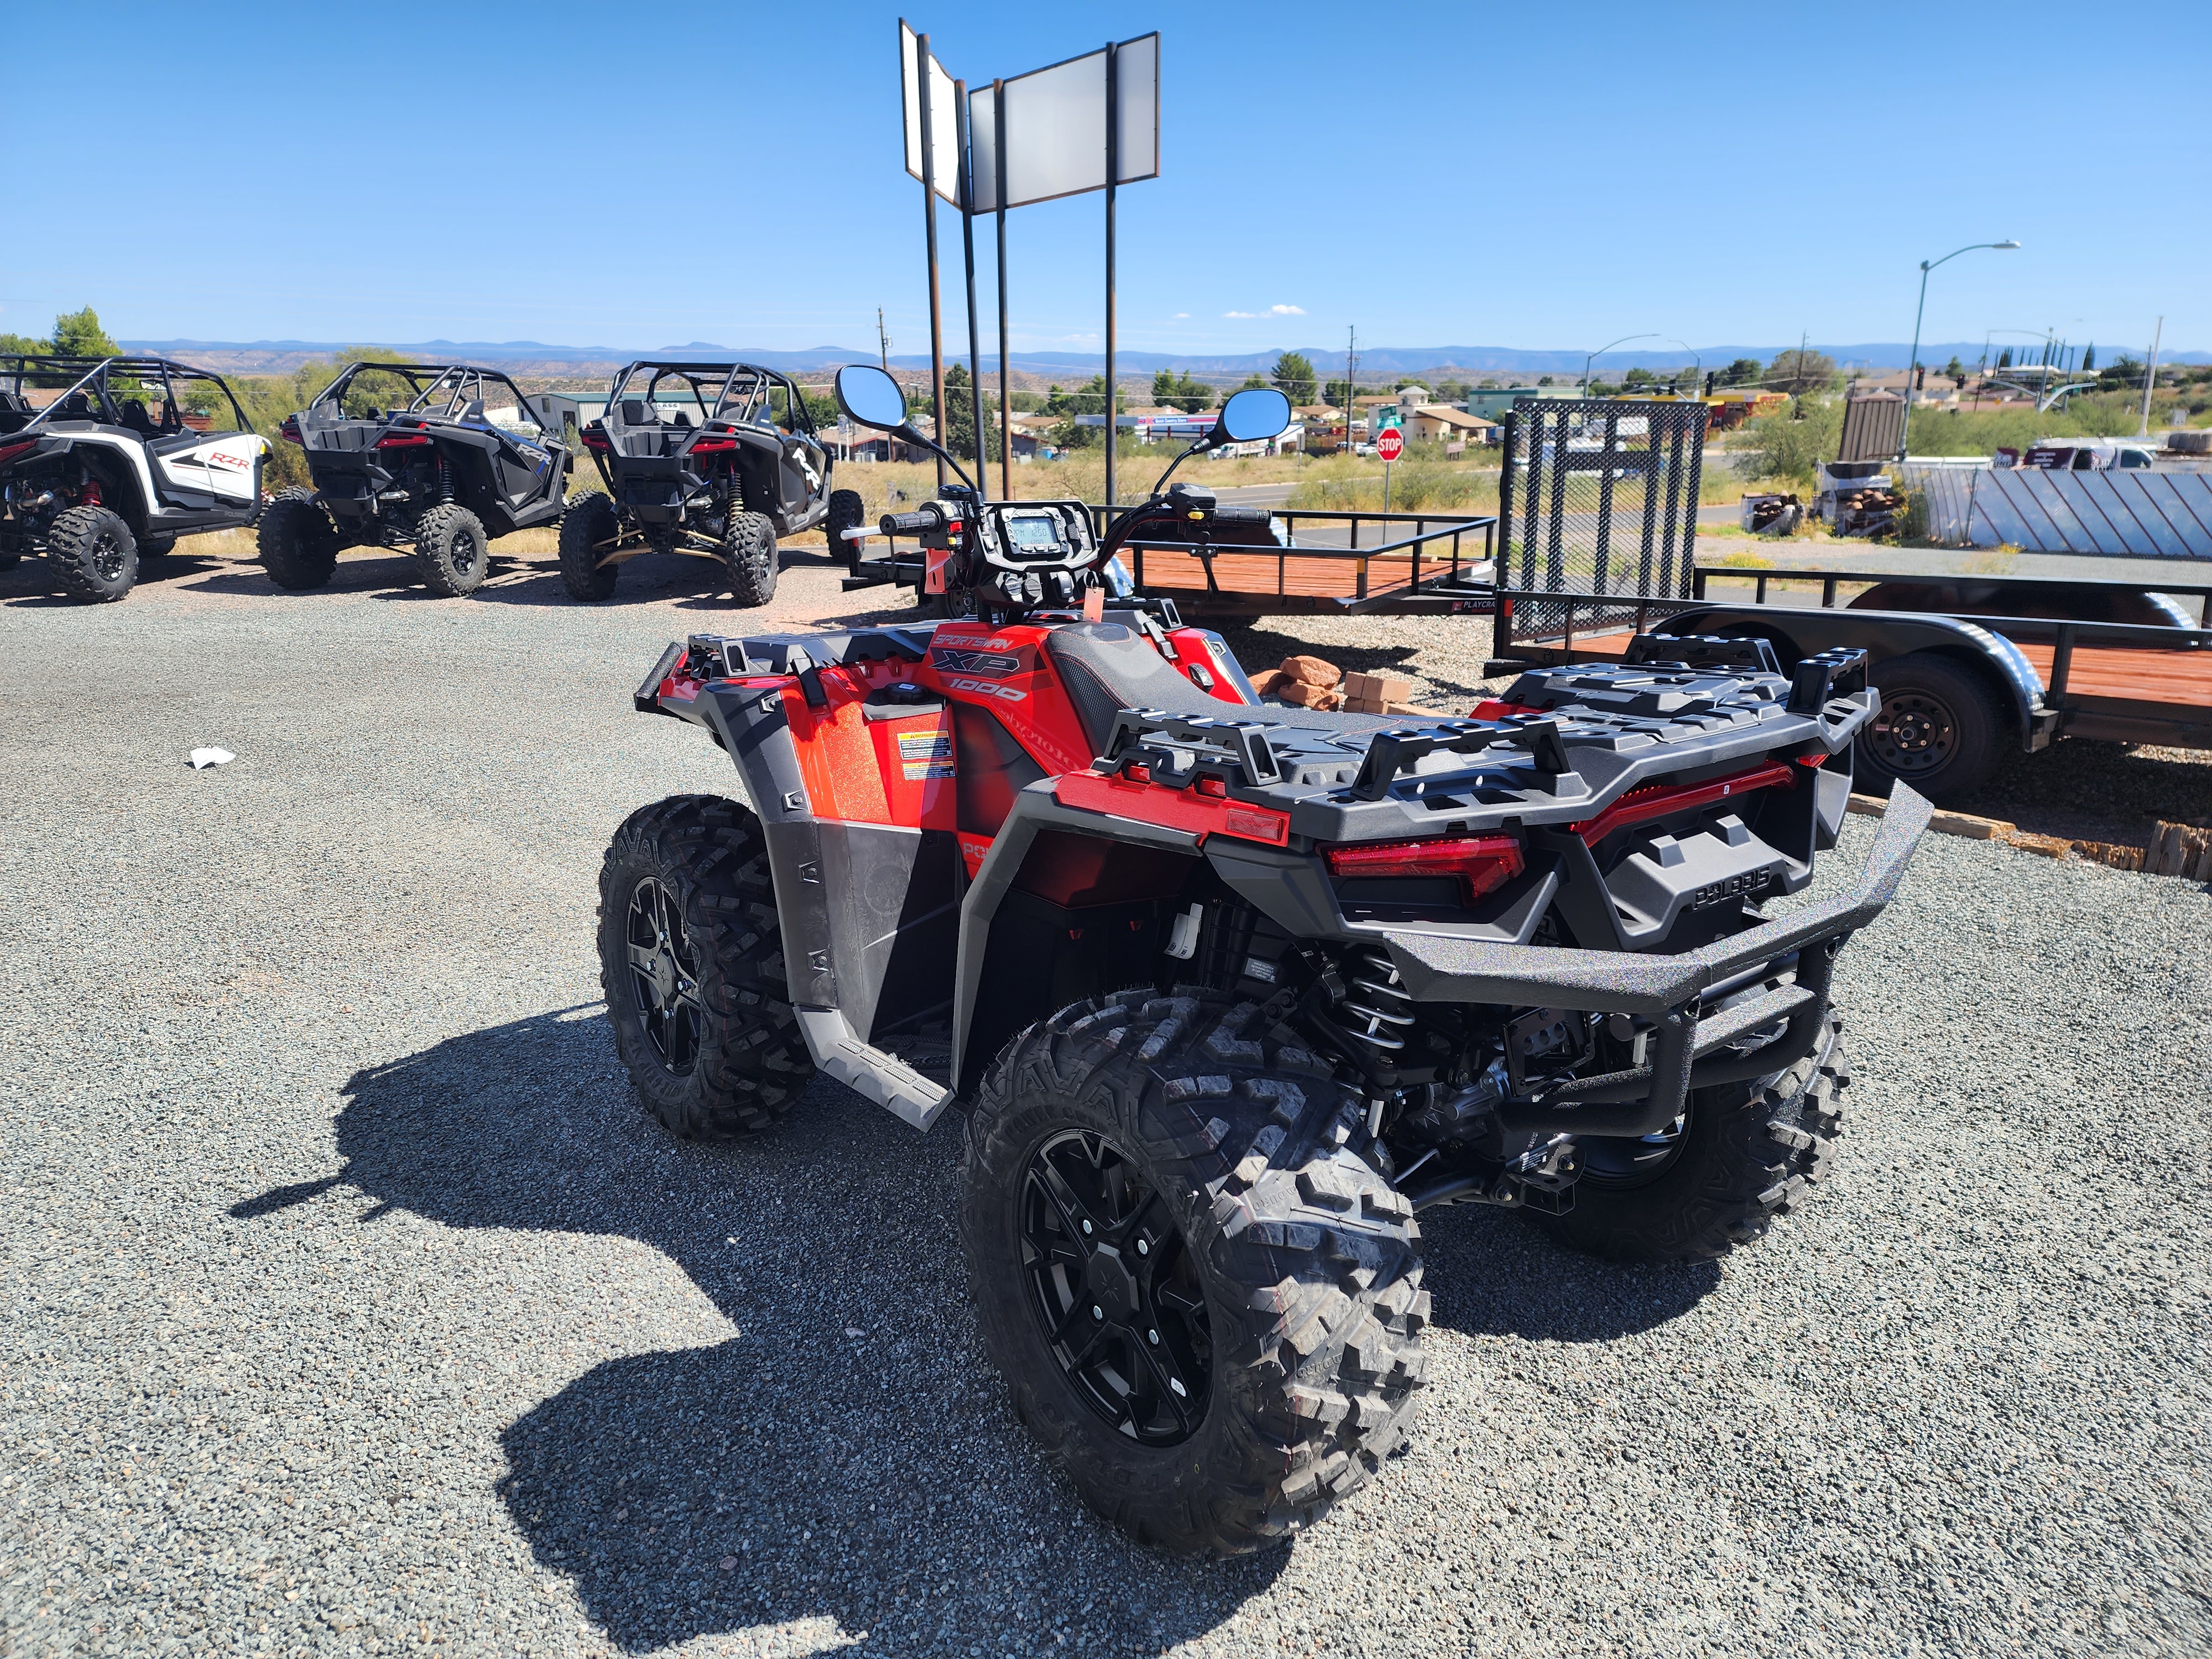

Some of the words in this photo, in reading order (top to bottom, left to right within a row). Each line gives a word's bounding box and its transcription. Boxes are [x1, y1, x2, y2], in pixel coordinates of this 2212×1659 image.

[517, 443, 552, 465] RZR
[1379, 437, 1401, 452] STOP
[209, 452, 249, 470] RZR
[792, 447, 820, 491] RZR
[933, 634, 1015, 650] SPORTSMAN
[928, 650, 1020, 673] XP
[950, 678, 1027, 702] 1000
[1693, 865, 1770, 911] POLARIS
